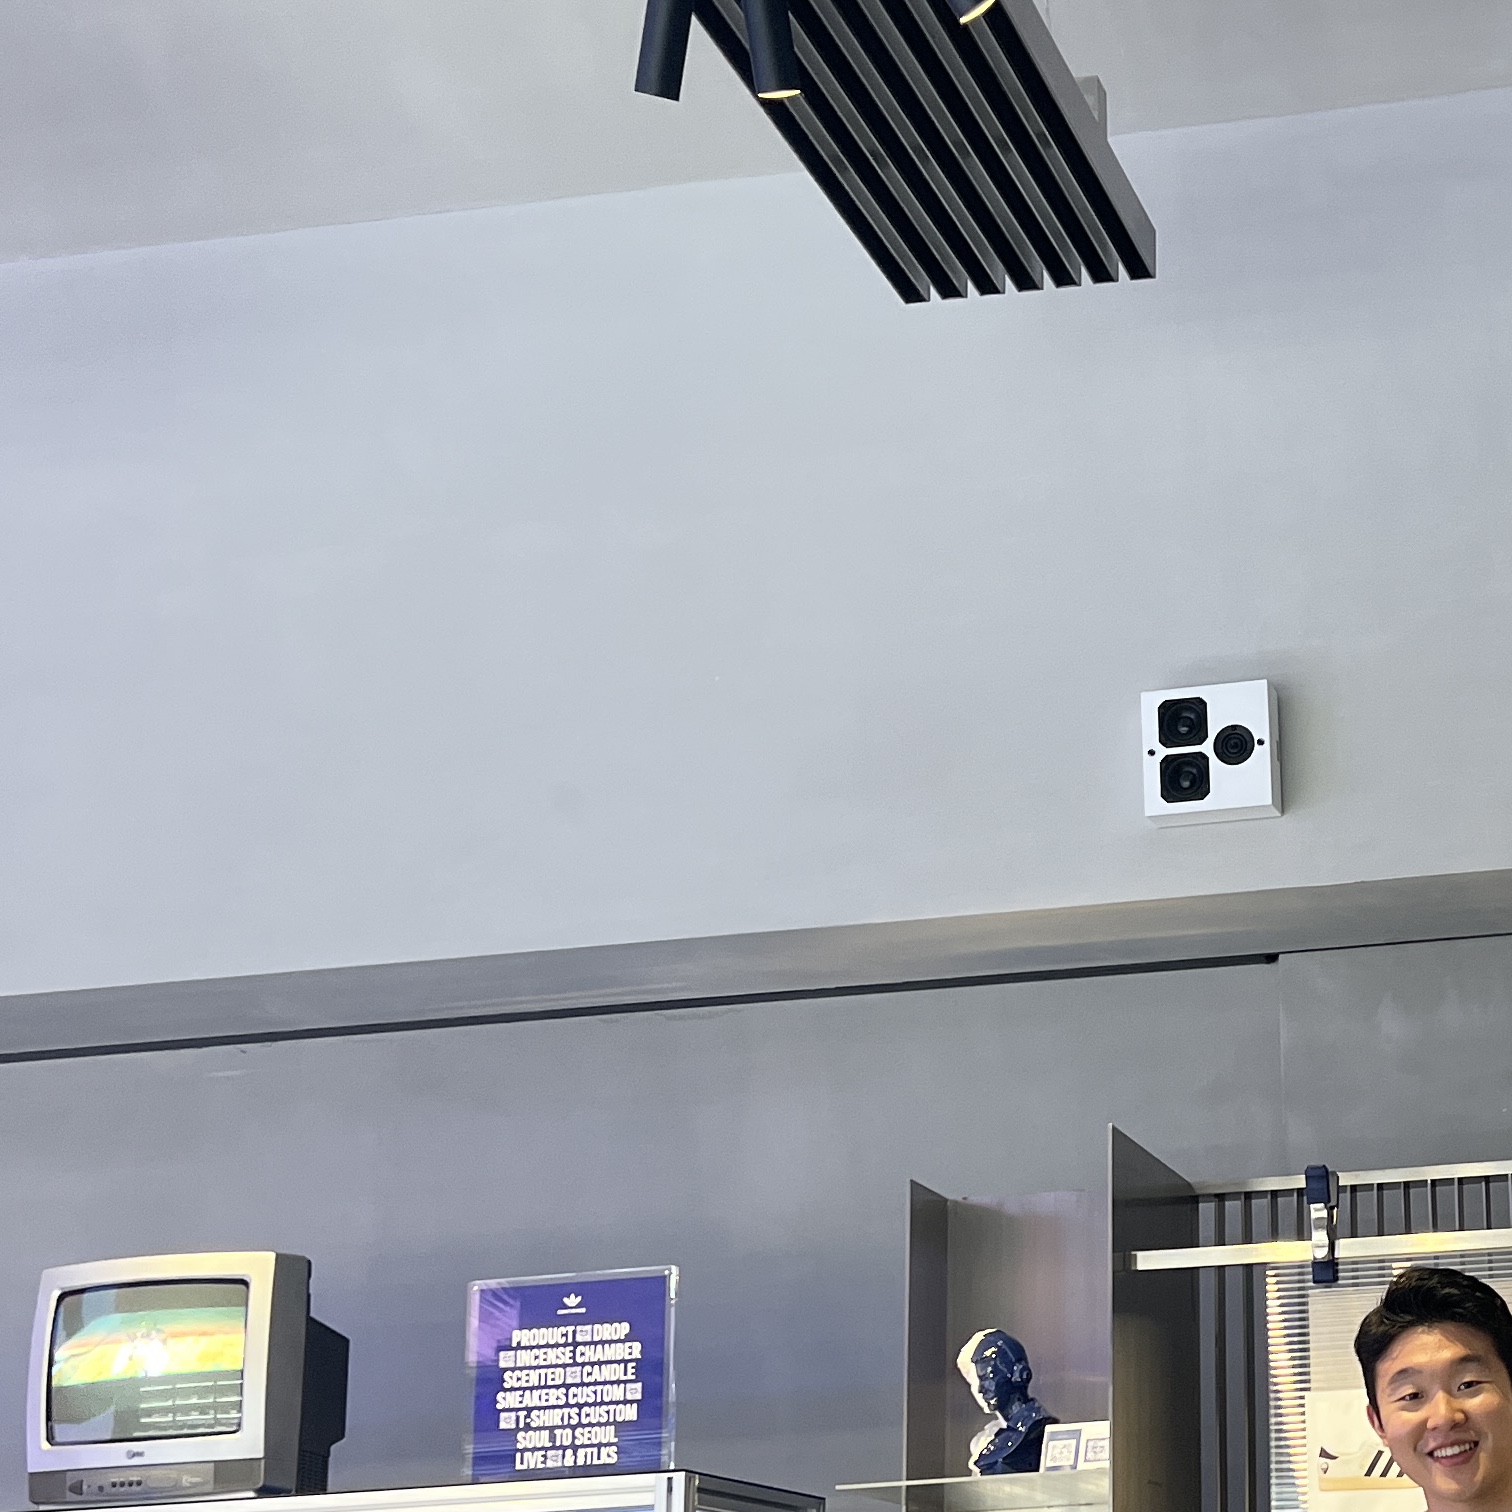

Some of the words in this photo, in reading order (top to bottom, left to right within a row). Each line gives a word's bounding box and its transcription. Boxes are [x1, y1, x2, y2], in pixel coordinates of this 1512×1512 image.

[512, 1326, 575, 1348] PRODUCT
[592, 1321, 630, 1342] DROP
[516, 1346, 573, 1367] INCENSE
[576, 1341, 642, 1363] CHAMBER
[502, 1368, 565, 1389] SCENTED
[582, 1362, 636, 1383] CANDLE
[496, 1387, 566, 1410] SNEAKERS
[568, 1383, 624, 1405] CUSTOM
[517, 1407, 579, 1428] T-SHIRTS
[581, 1403, 638, 1425] CUSTOM
[516, 1429, 552, 1450] SOUL
[554, 1428, 573, 1447] TO
[574, 1425, 618, 1446] SEOUL
[515, 1450, 546, 1471] LIVE
[563, 1448, 576, 1467] &
